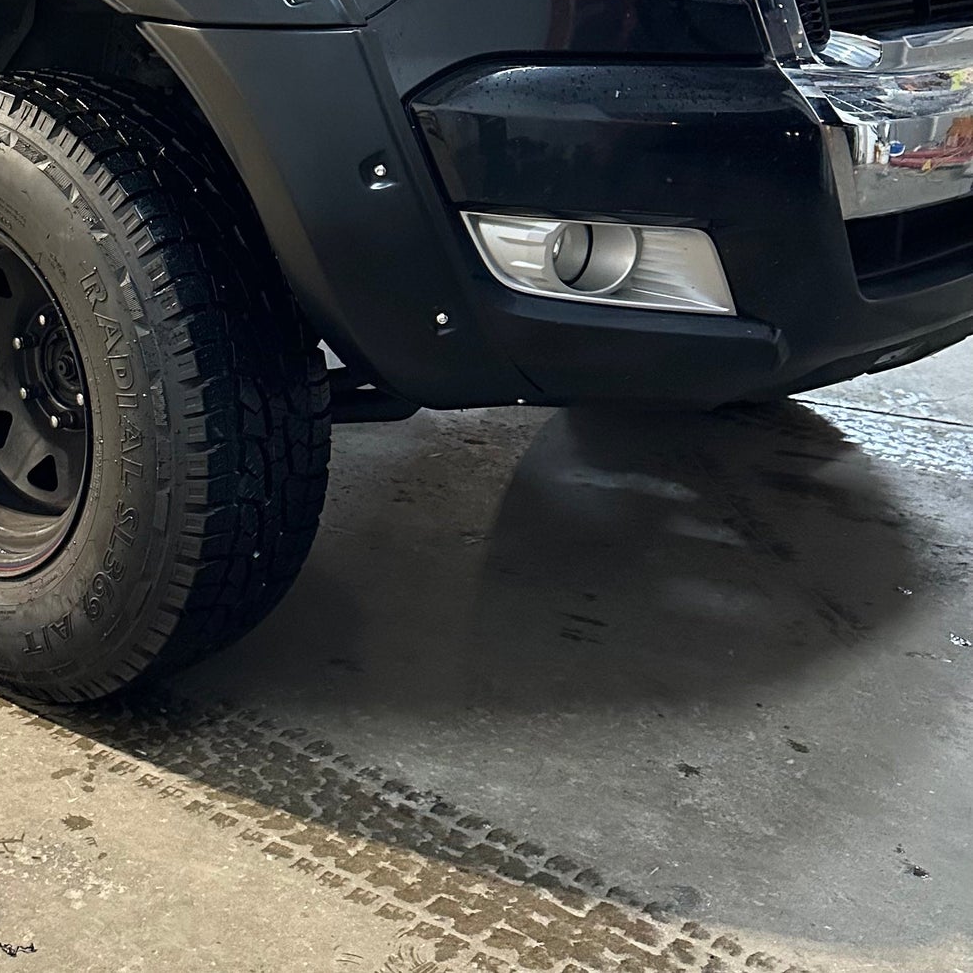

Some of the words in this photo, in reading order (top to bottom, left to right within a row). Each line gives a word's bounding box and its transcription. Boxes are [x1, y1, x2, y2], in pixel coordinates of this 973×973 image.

[79, 268, 144, 480] RADIAL
[84, 499, 139, 621] SL369
[20, 612, 75, 656] A/T
